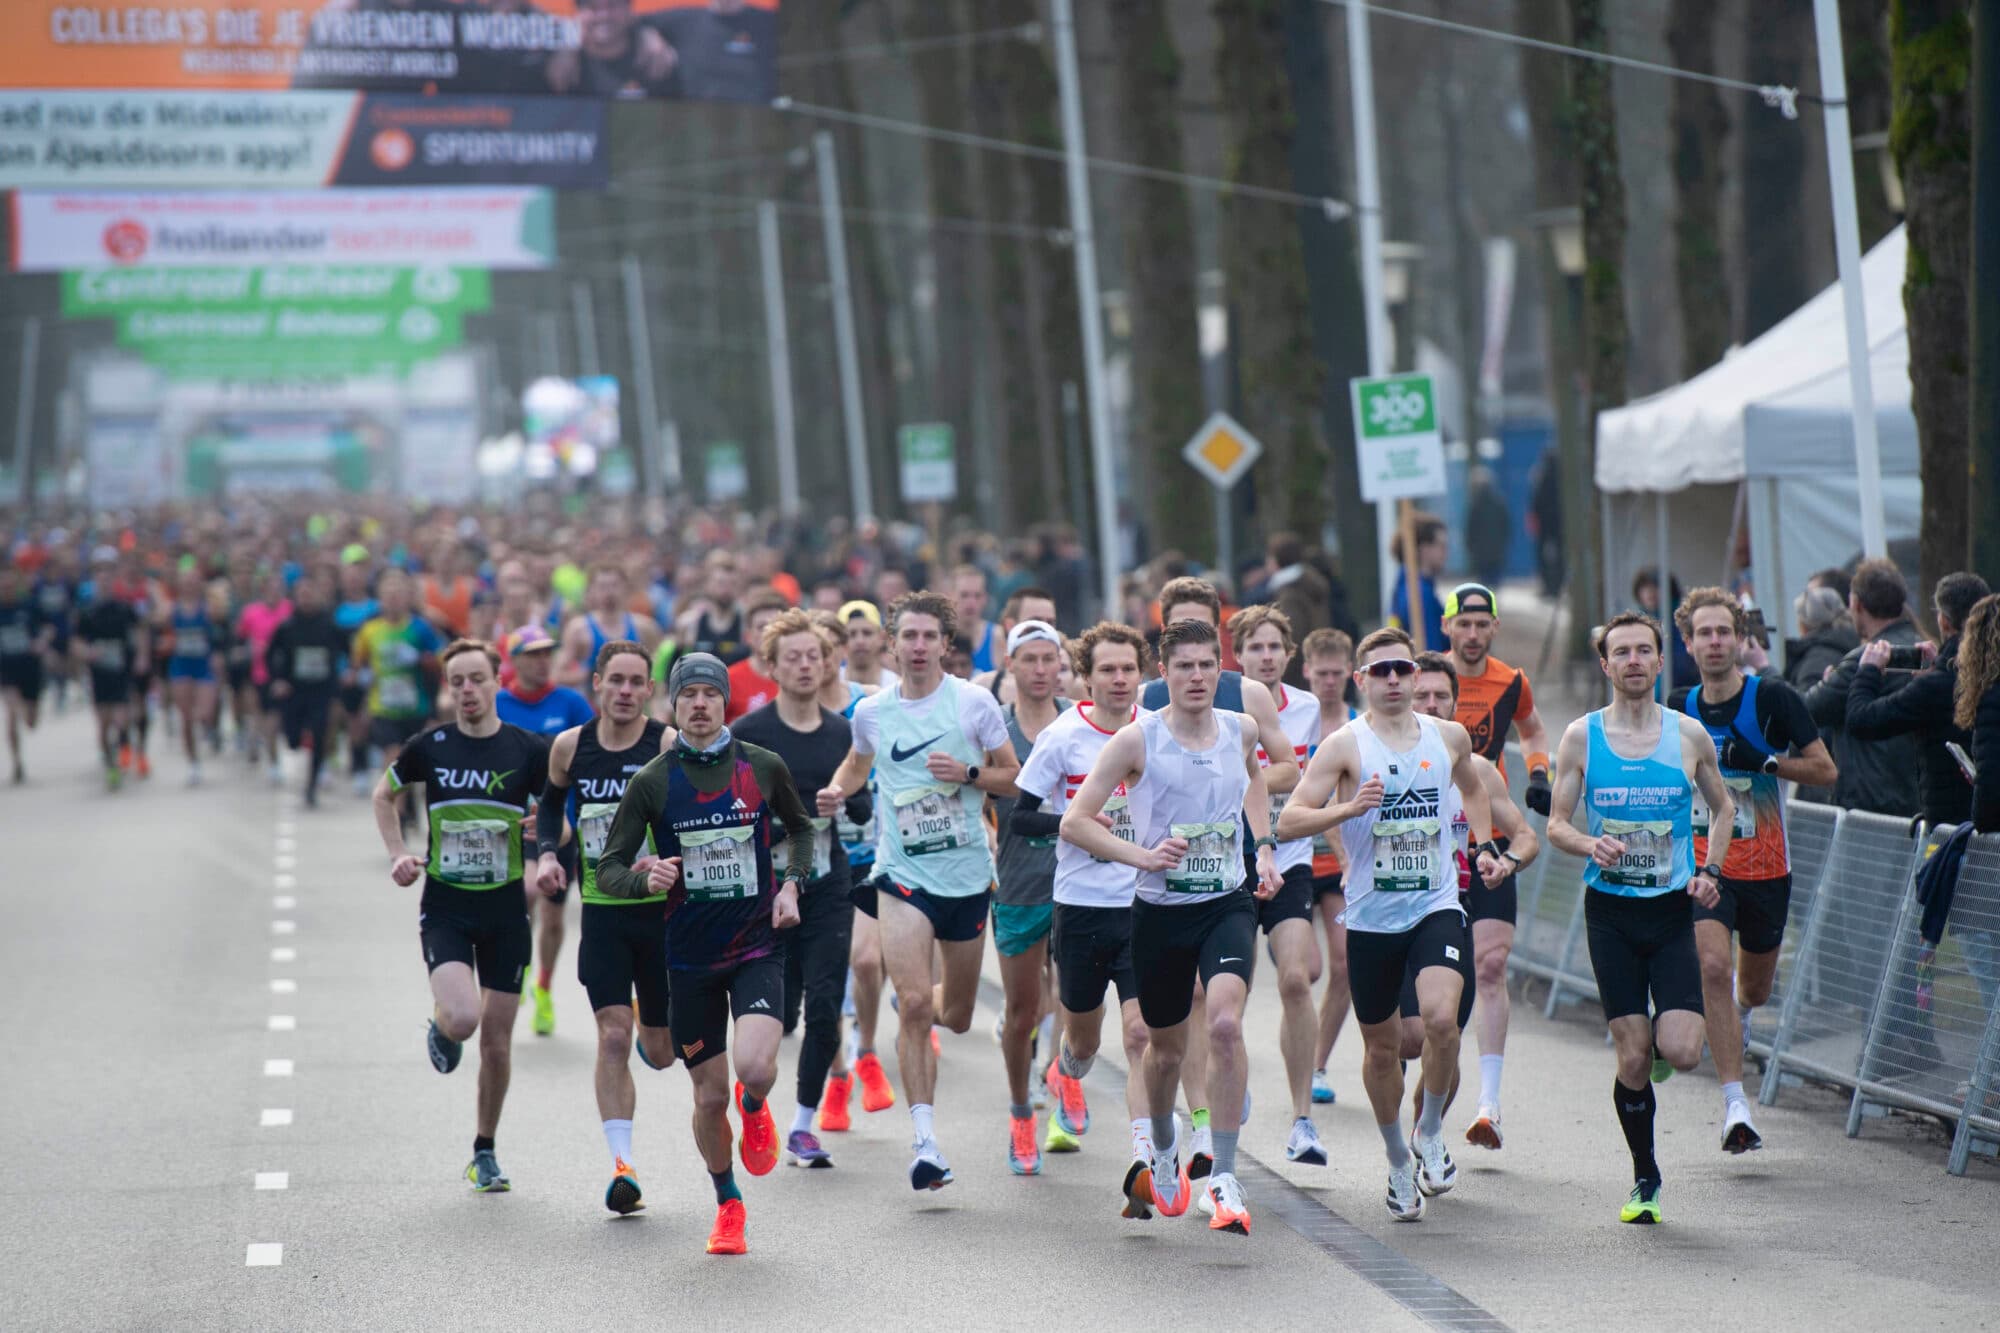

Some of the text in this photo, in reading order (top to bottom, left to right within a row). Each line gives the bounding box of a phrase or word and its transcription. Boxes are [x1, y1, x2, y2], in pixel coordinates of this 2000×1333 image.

[53, 8, 582, 49] COLLEGA'S DIE JE VRIENDEN WORDEN
[52, 103, 94, 125] nu
[105, 100, 142, 125] de
[47, 138, 226, 171] Apeldoorn
[424, 131, 597, 165] SPORTUNITY
[1368, 391, 1426, 425] 300
[434, 767, 518, 795] RUNX
[1629, 786, 1683, 798] RUNNERS
[1629, 796, 1669, 806] WORLD
[922, 804, 937, 815] IMO
[1380, 805, 1439, 821] NOWAK
[672, 811, 760, 830] CINEMA ALBERT
[917, 816, 951, 835] 10026
[1391, 840, 1426, 852] WOUTER
[458, 851, 494, 866] 13429
[704, 848, 734, 861] VINNIE
[1619, 854, 1656, 868] 10036
[1186, 857, 1222, 873] 10037
[1391, 855, 1428, 871] 10010
[702, 863, 741, 881] 10018
